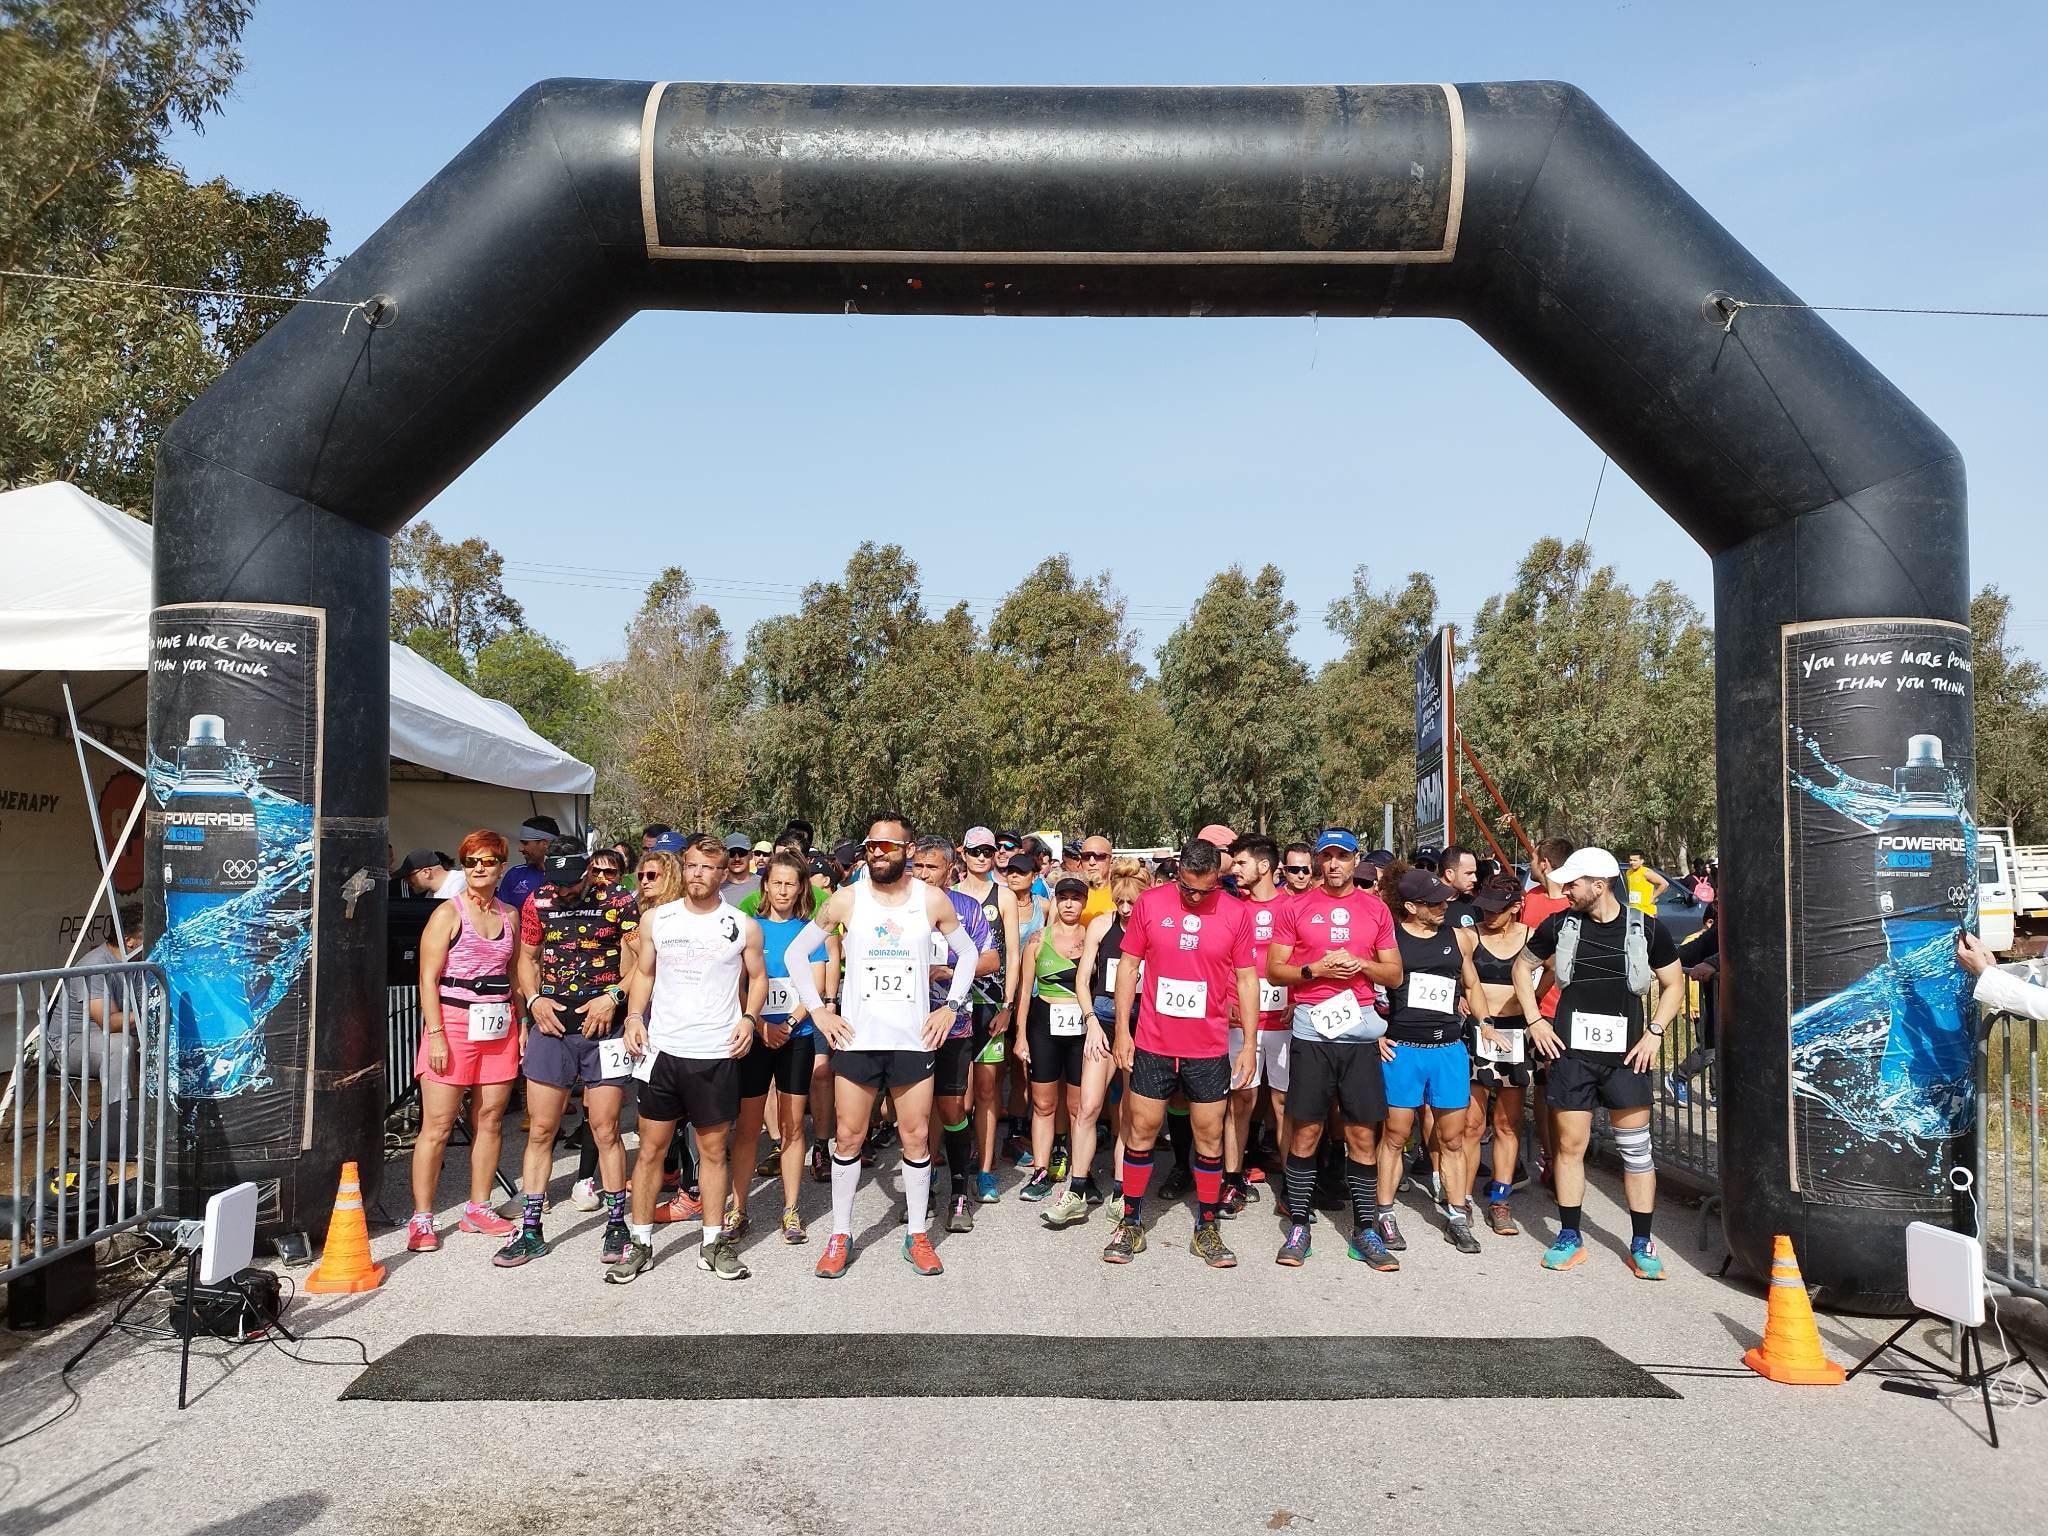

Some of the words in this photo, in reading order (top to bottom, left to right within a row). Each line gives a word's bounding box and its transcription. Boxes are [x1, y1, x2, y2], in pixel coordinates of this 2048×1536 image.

[186, 633, 229, 650] MORE
[236, 632, 298, 655] POWER
[153, 658, 178, 673] THAN
[183, 659, 207, 674] YOU
[214, 658, 269, 677] THINK
[1802, 653, 1835, 679] YOU
[1844, 651, 1893, 667] HAVE
[1900, 650, 1943, 668] MORE
[1836, 675, 1888, 691] THAN
[1896, 677, 1924, 692] YOU
[1931, 677, 1966, 697] THINK
[164, 812, 255, 827] POWERADE
[1878, 836, 1967, 852] POWERADE
[874, 975, 902, 991] 152
[1165, 992, 1196, 1008] 206
[1261, 989, 1280, 1003] 78
[1418, 985, 1448, 1002] 269
[480, 1015, 504, 1031] 178
[1322, 1005, 1351, 1030] 235
[1584, 1026, 1613, 1043] 183
